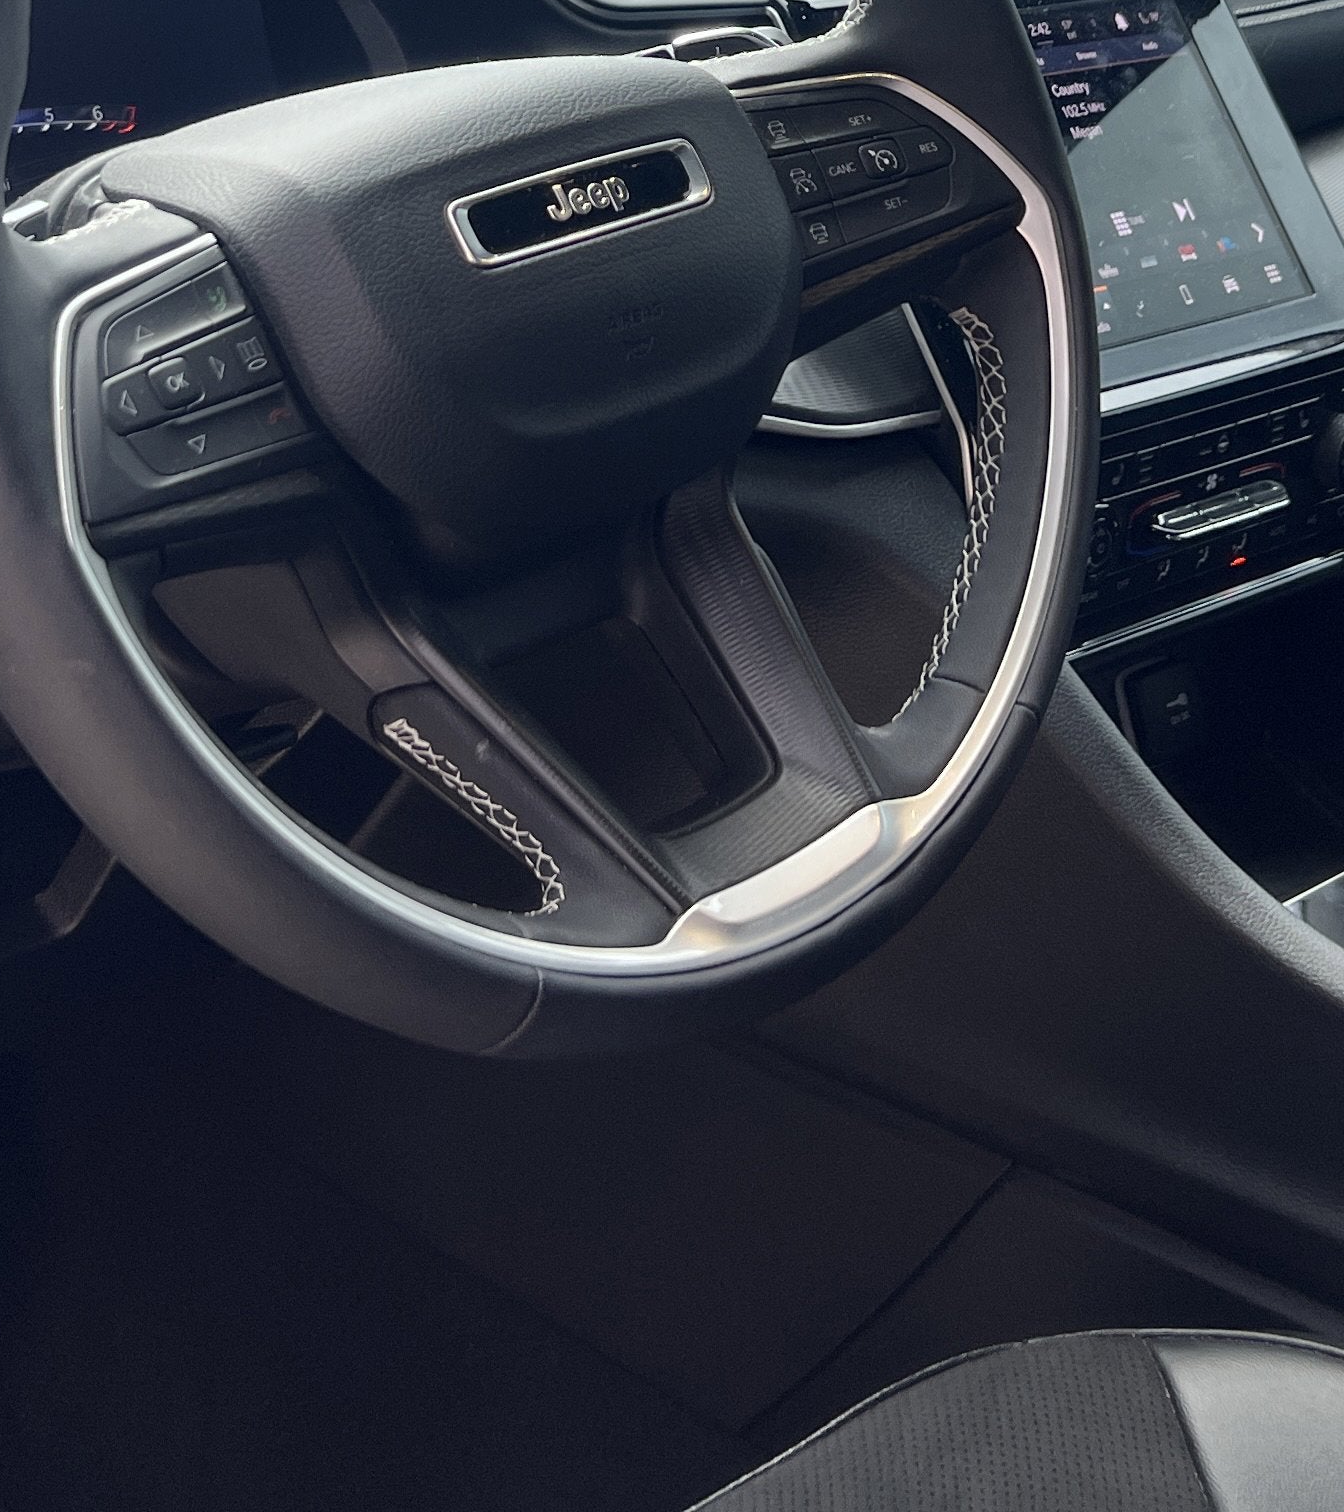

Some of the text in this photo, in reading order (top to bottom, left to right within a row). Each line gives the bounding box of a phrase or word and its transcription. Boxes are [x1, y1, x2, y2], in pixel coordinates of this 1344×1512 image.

[1051, 82, 1090, 98] Country
[44, 108, 54, 122] 5
[92, 105, 103, 121] 6
[848, 114, 872, 127] SET+
[918, 141, 938, 154] RES
[828, 161, 856, 177] CANC
[546, 176, 630, 222] Jeep
[166, 371, 190, 393] OK
